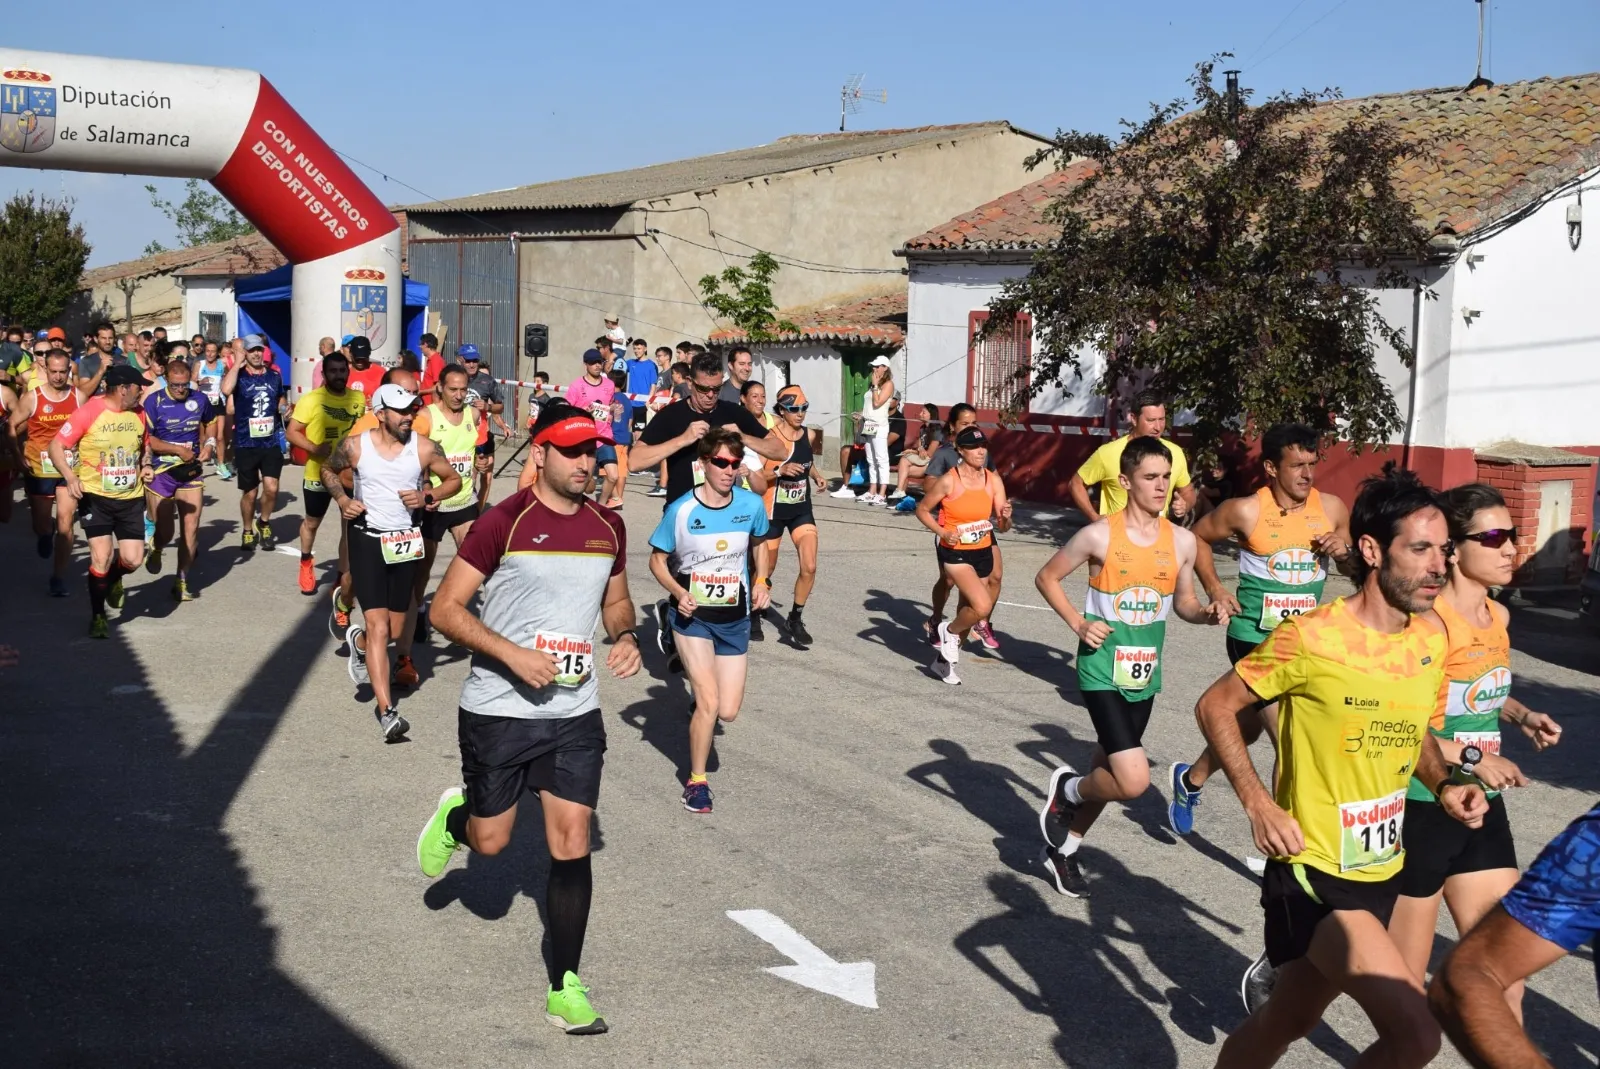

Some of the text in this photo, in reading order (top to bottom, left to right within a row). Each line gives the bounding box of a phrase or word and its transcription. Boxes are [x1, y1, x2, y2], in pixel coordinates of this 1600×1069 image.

[62, 85, 171, 109] Diputación
[59, 124, 190, 148] de Salamanca
[263, 119, 369, 231] CON NUESTROS
[251, 140, 348, 239] DEPORTISTAS
[595, 409, 604, 417] 72
[102, 421, 138, 433] MIGUEL
[258, 424, 268, 432] 41
[103, 467, 136, 476] bedunia
[114, 476, 128, 486] 23
[785, 488, 803, 499] 109
[381, 530, 422, 544] bedunia
[394, 540, 412, 555] 27
[1273, 561, 1317, 572] ALCER
[692, 571, 740, 585] bedunia
[705, 584, 725, 598] 73
[1117, 600, 1158, 613] ALCER
[1264, 595, 1316, 609] bedunia
[535, 634, 592, 654] bedunia
[552, 653, 584, 675] 15
[1131, 662, 1152, 679] 89
[1354, 697, 1380, 707] Loiola
[1370, 719, 1417, 735] media
[1455, 736, 1500, 753] dunia
[1341, 796, 1404, 828] bedunia
[1360, 818, 1397, 852] 118
